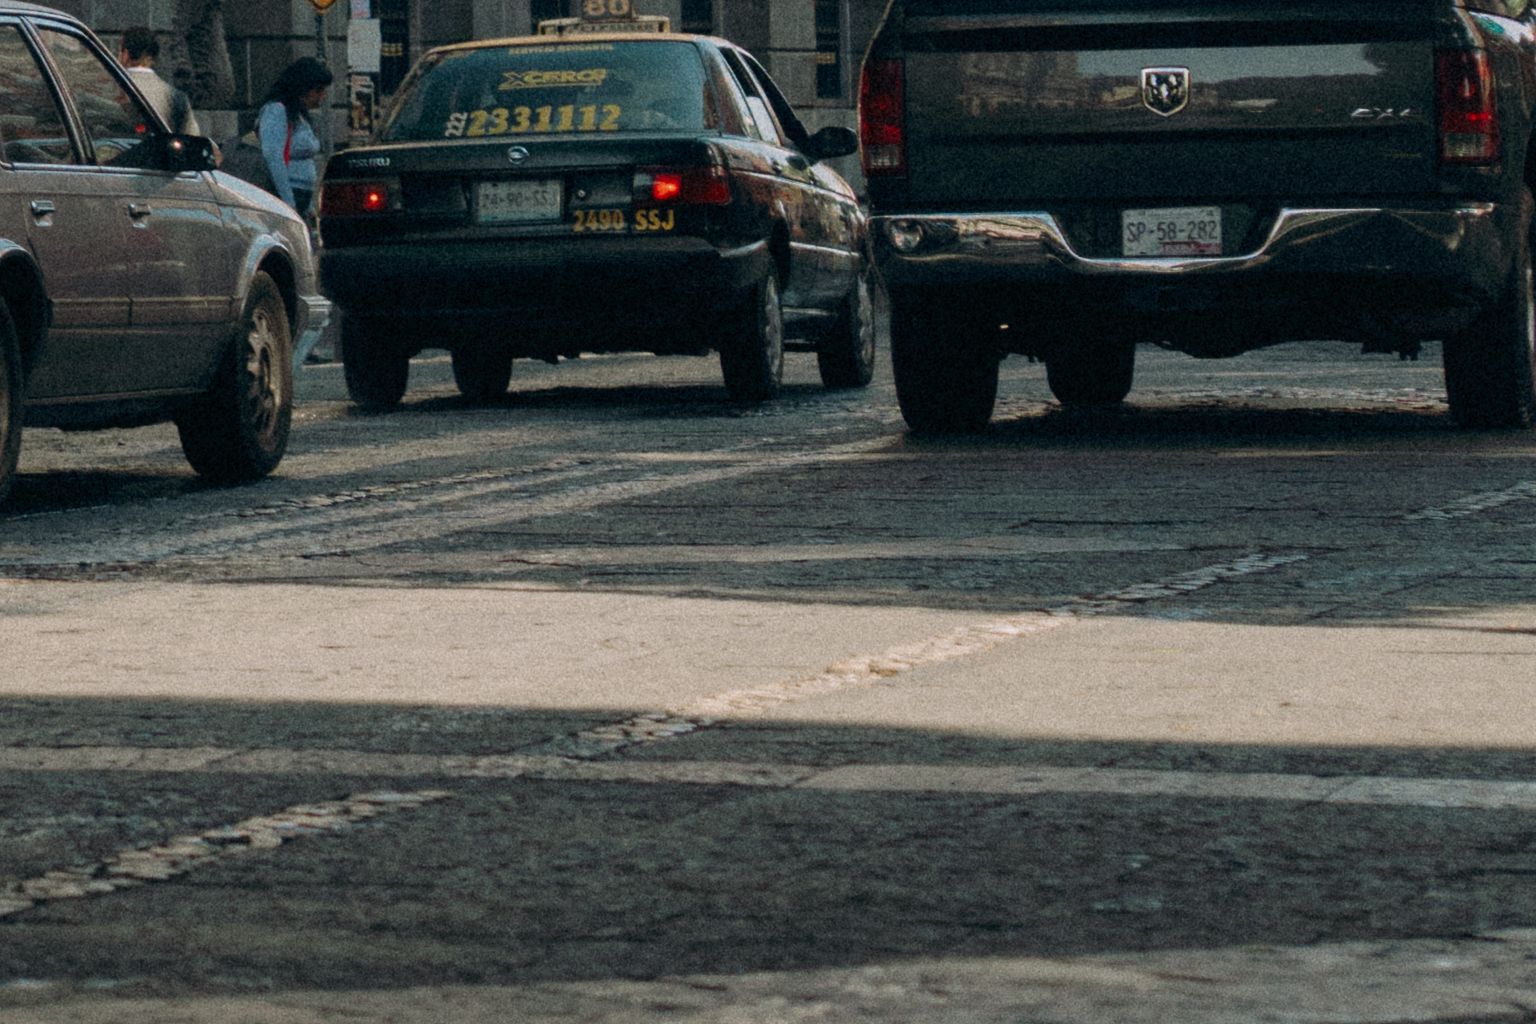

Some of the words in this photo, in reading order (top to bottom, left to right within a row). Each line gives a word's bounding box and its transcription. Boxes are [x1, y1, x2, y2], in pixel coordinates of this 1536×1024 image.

[467, 103, 622, 137] 2331112
[572, 209, 626, 233] 2490
[634, 207, 676, 231] SSJ
[1126, 219, 1217, 244] SP-58-282
